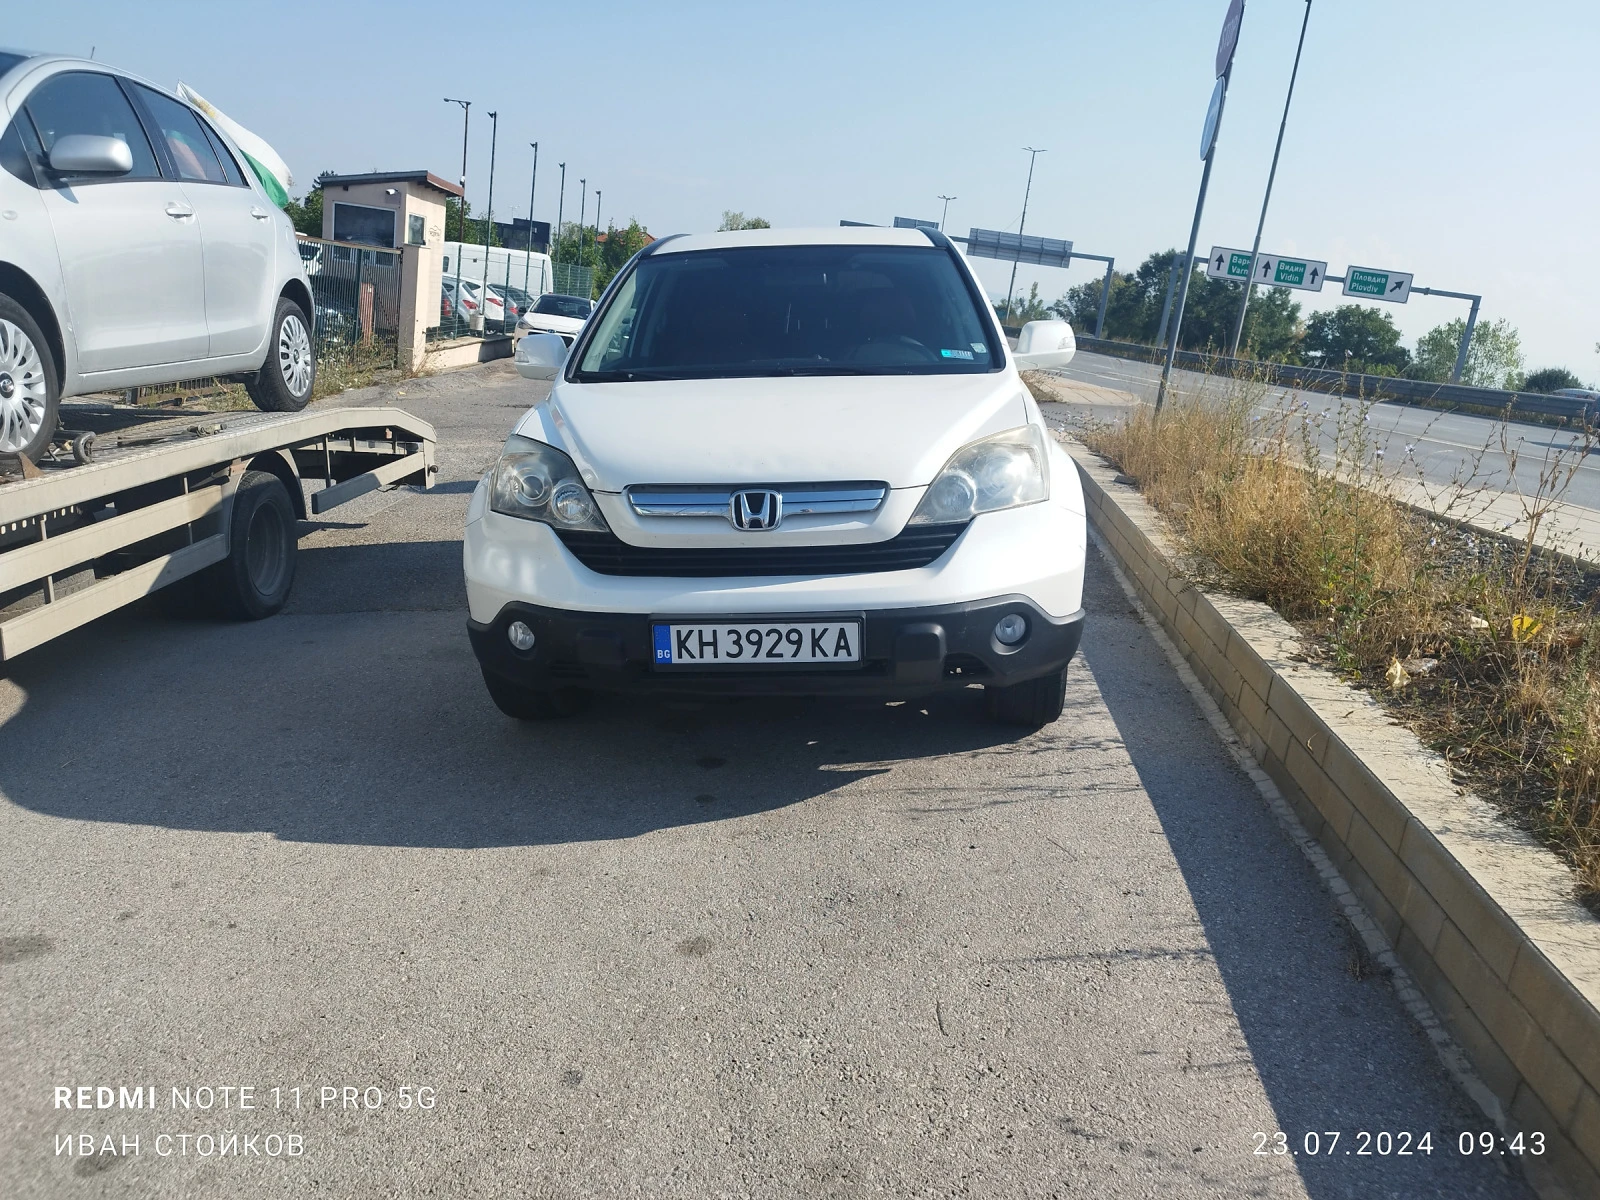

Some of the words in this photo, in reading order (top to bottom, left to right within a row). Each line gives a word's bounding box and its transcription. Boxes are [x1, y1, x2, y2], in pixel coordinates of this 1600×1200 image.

[1231, 255, 1251, 265] Варн
[1231, 265, 1249, 275] Varn
[1279, 262, 1304, 273] Видин
[1280, 272, 1299, 282] Vidin
[1353, 272, 1386, 284] Пловдив
[1351, 282, 1379, 293] Plovdiv
[657, 649, 671, 659] BG
